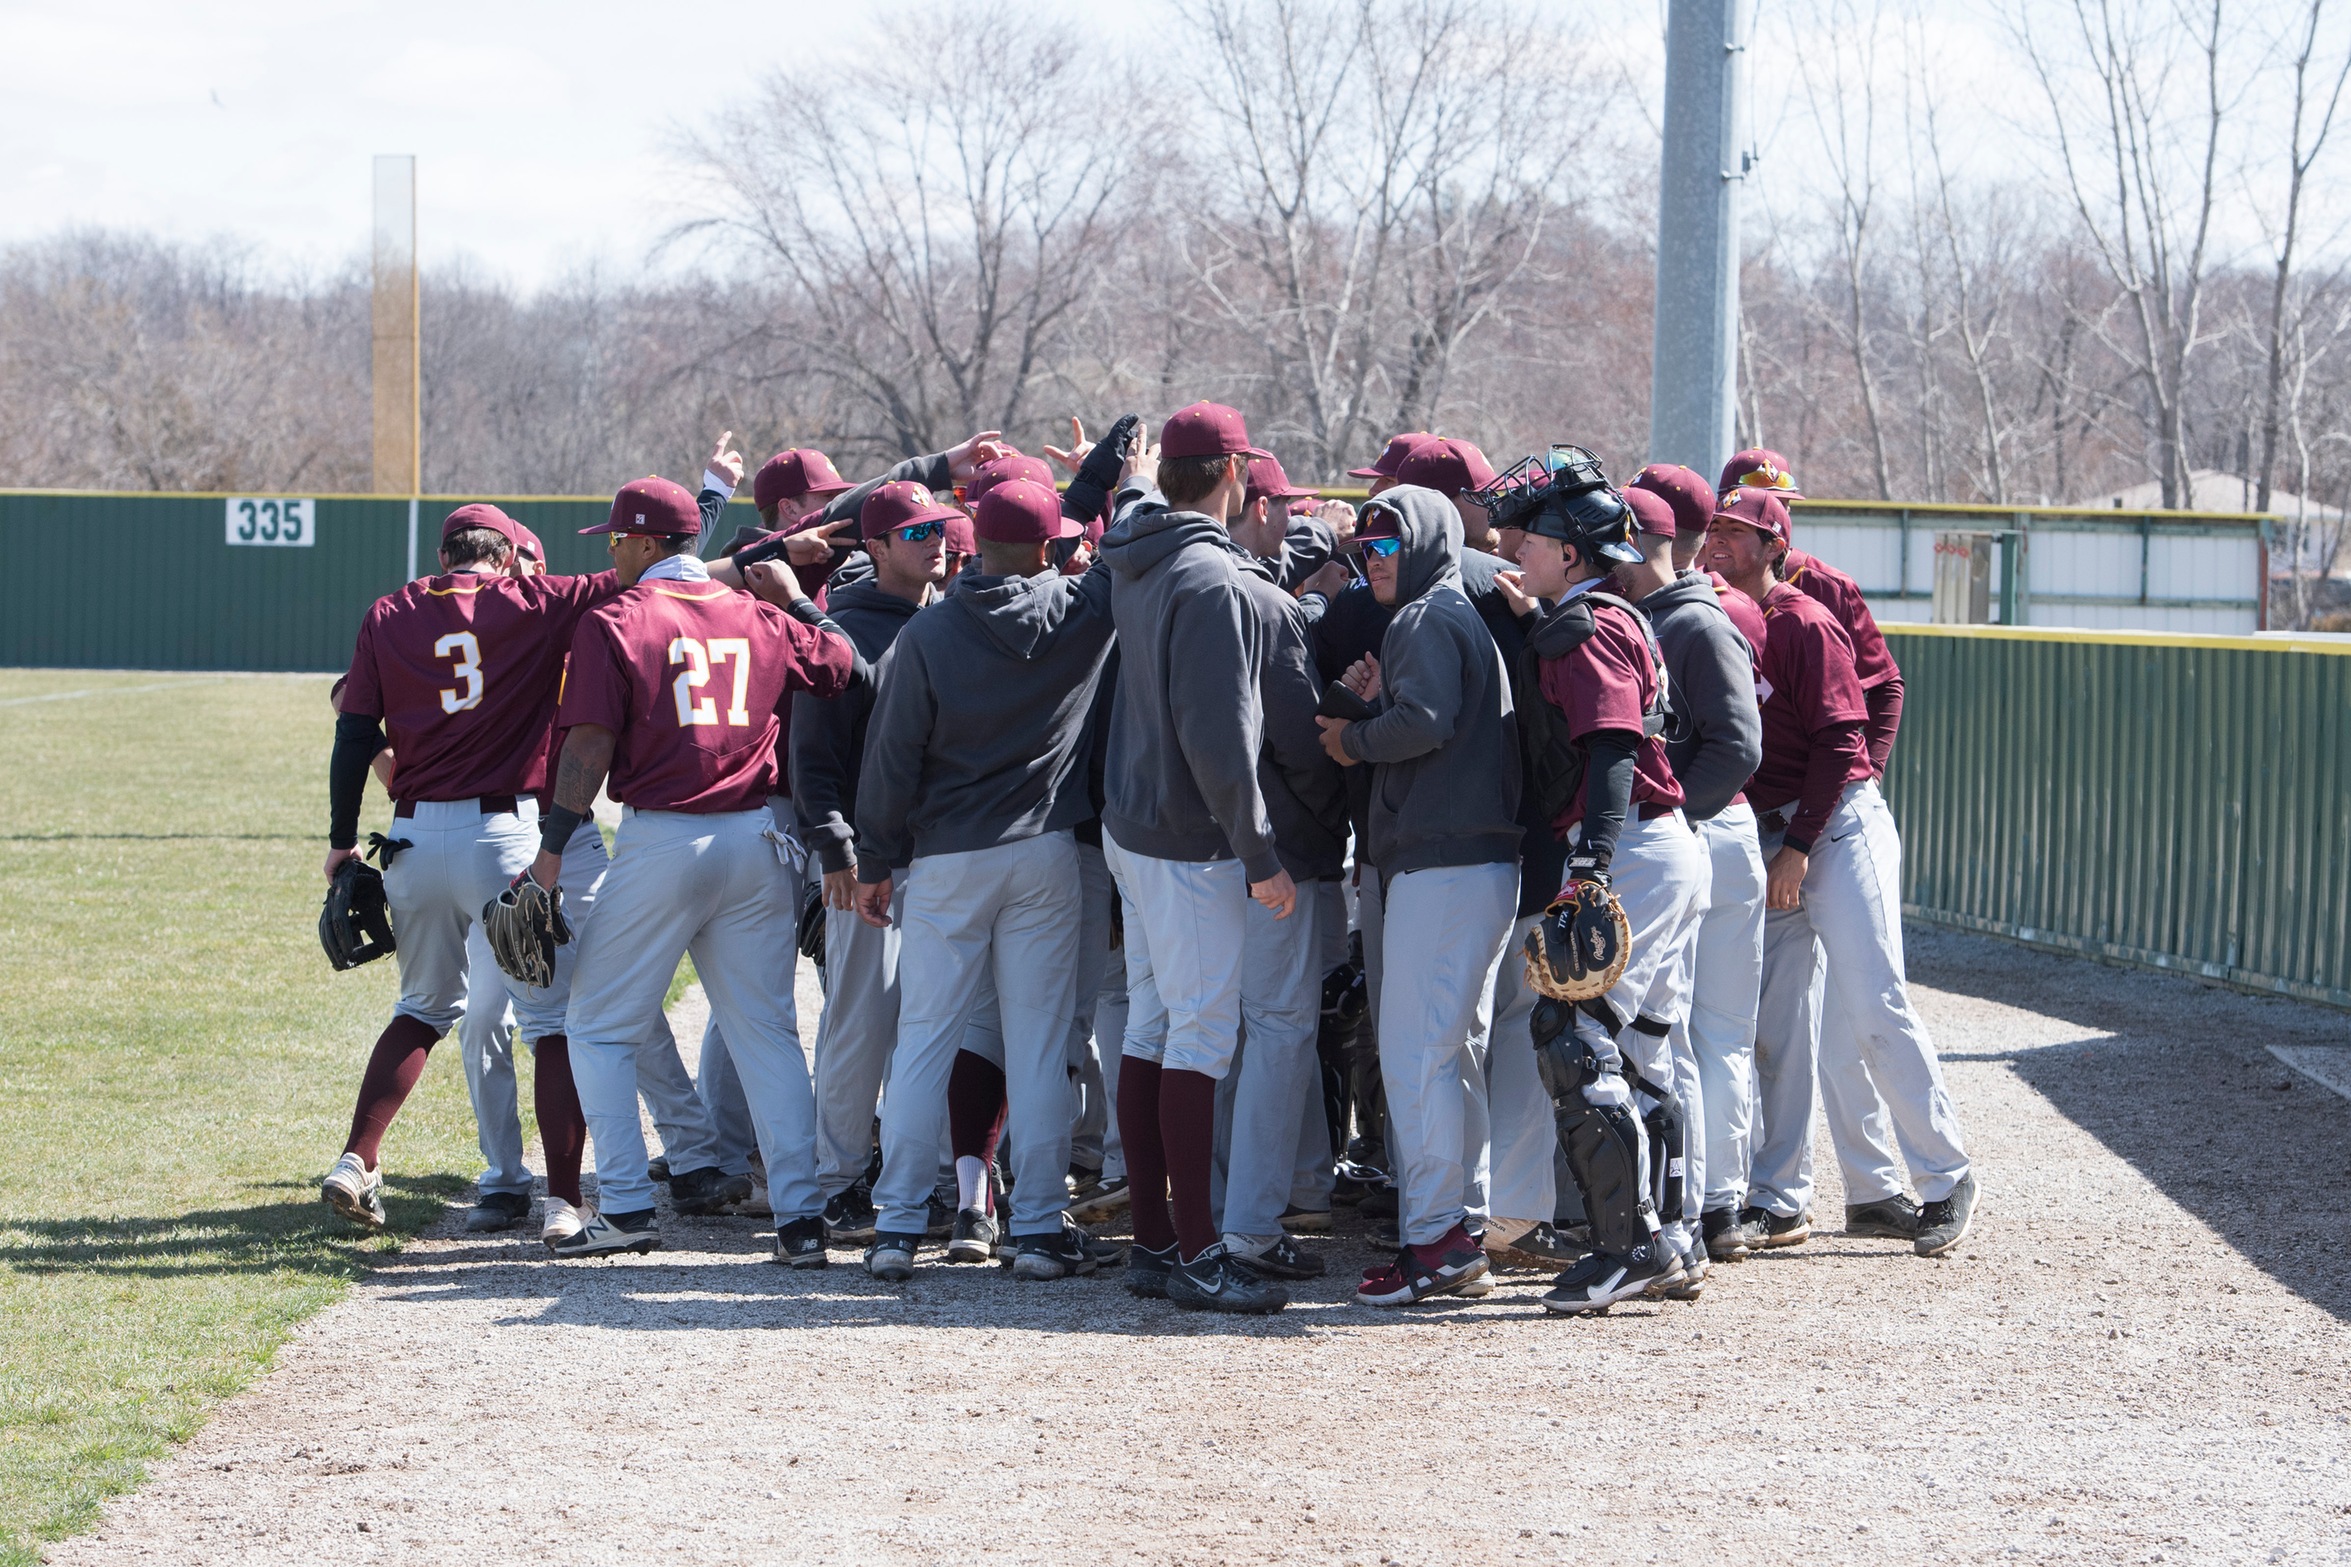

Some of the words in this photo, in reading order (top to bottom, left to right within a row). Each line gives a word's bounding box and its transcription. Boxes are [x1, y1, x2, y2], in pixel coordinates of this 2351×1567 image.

[238, 501, 302, 541] 335
[434, 630, 484, 714] 3
[668, 637, 751, 727] 27
[1558, 911, 1568, 928] TPX
